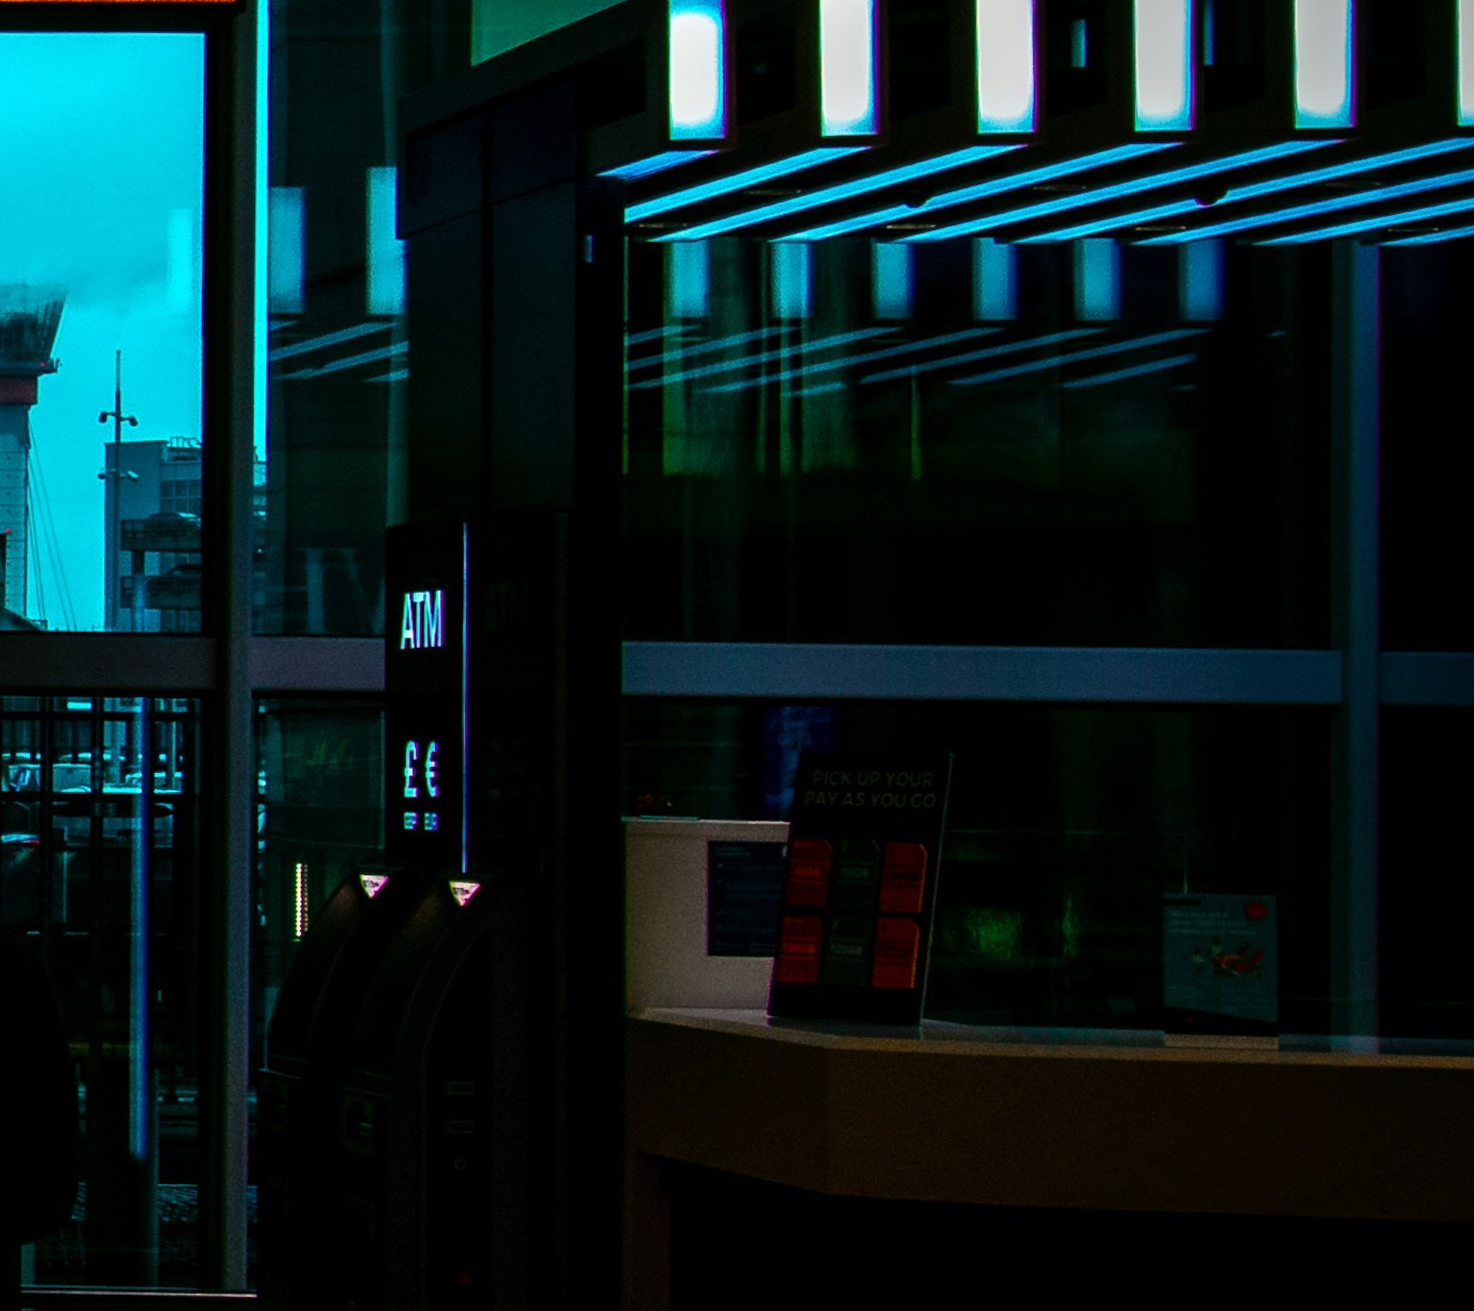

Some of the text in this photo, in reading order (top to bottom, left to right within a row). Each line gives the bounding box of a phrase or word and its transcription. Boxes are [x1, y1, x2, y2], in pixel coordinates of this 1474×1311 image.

[400, 589, 444, 650] ATM
[403, 740, 439, 799] £ €
[812, 770, 934, 787] PICK UP YOUR
[803, 790, 937, 809] PAY AS YOU GO
